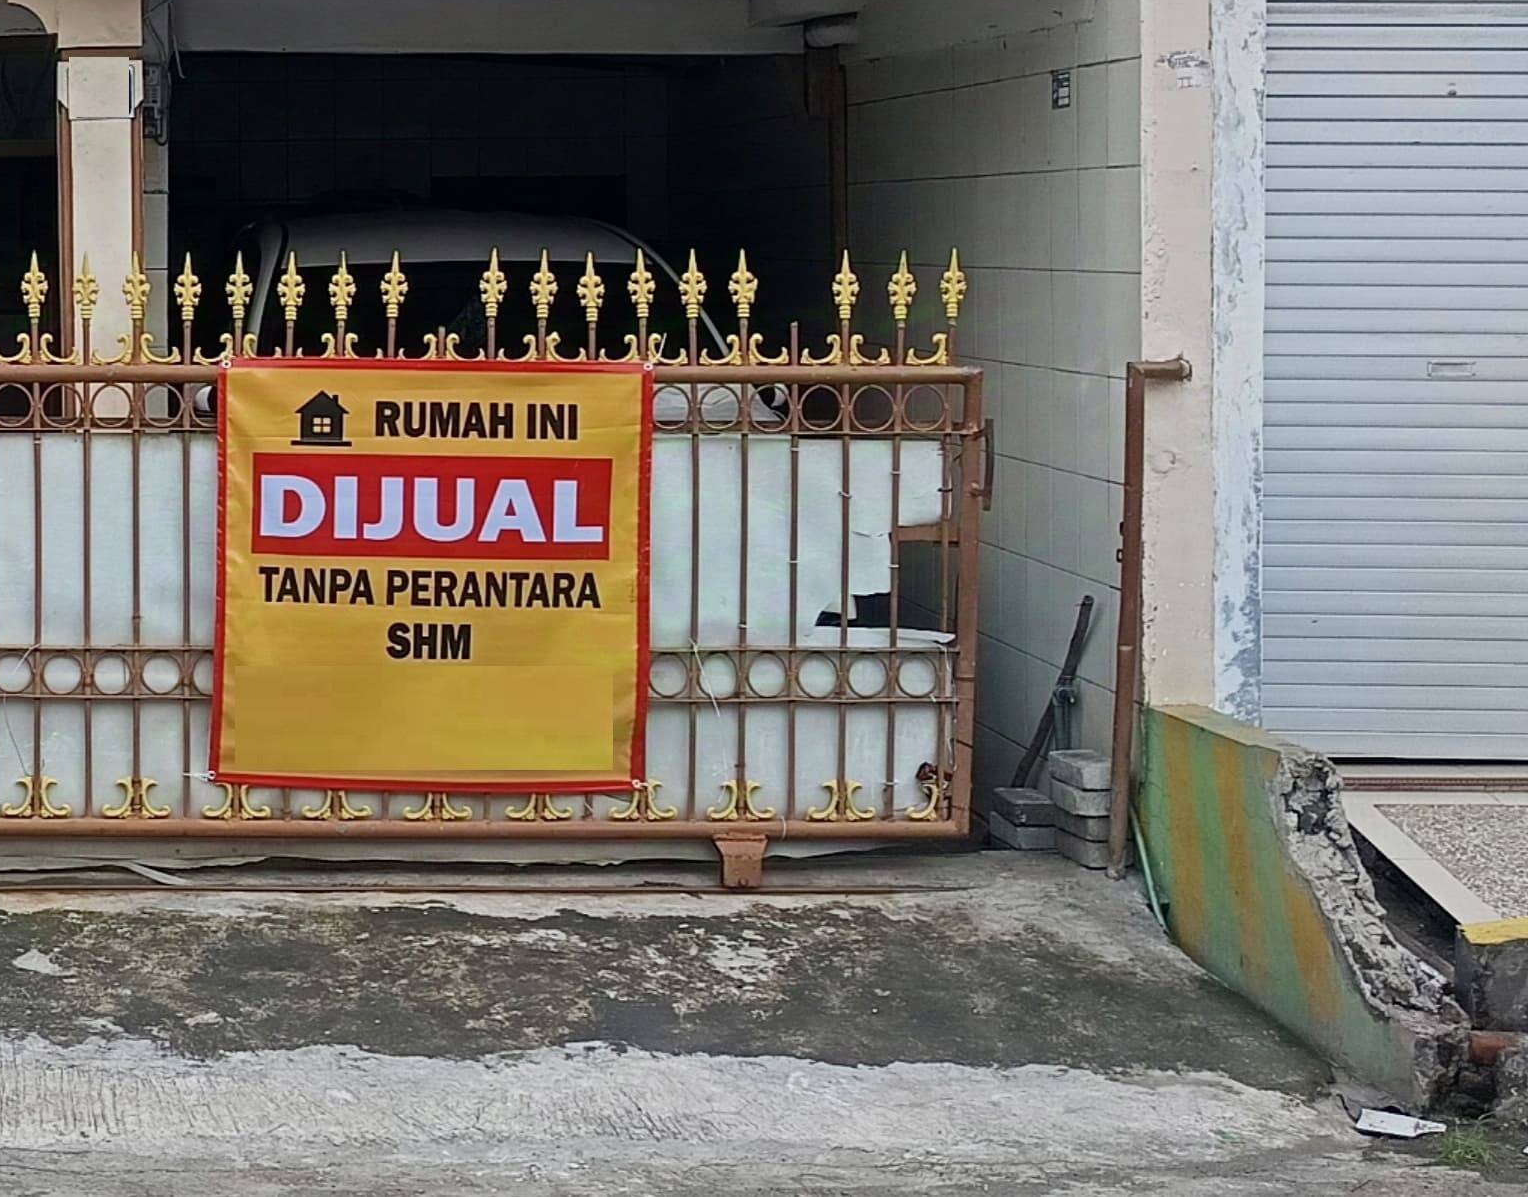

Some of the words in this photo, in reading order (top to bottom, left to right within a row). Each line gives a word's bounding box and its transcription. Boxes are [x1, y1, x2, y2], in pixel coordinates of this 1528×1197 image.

[375, 401, 513, 440] RUMAH
[527, 403, 579, 440] INI
[259, 474, 603, 543] DIJUAL
[259, 566, 374, 605] TANPA
[386, 569, 601, 609] PERANTARA
[386, 622, 472, 661] SHM
